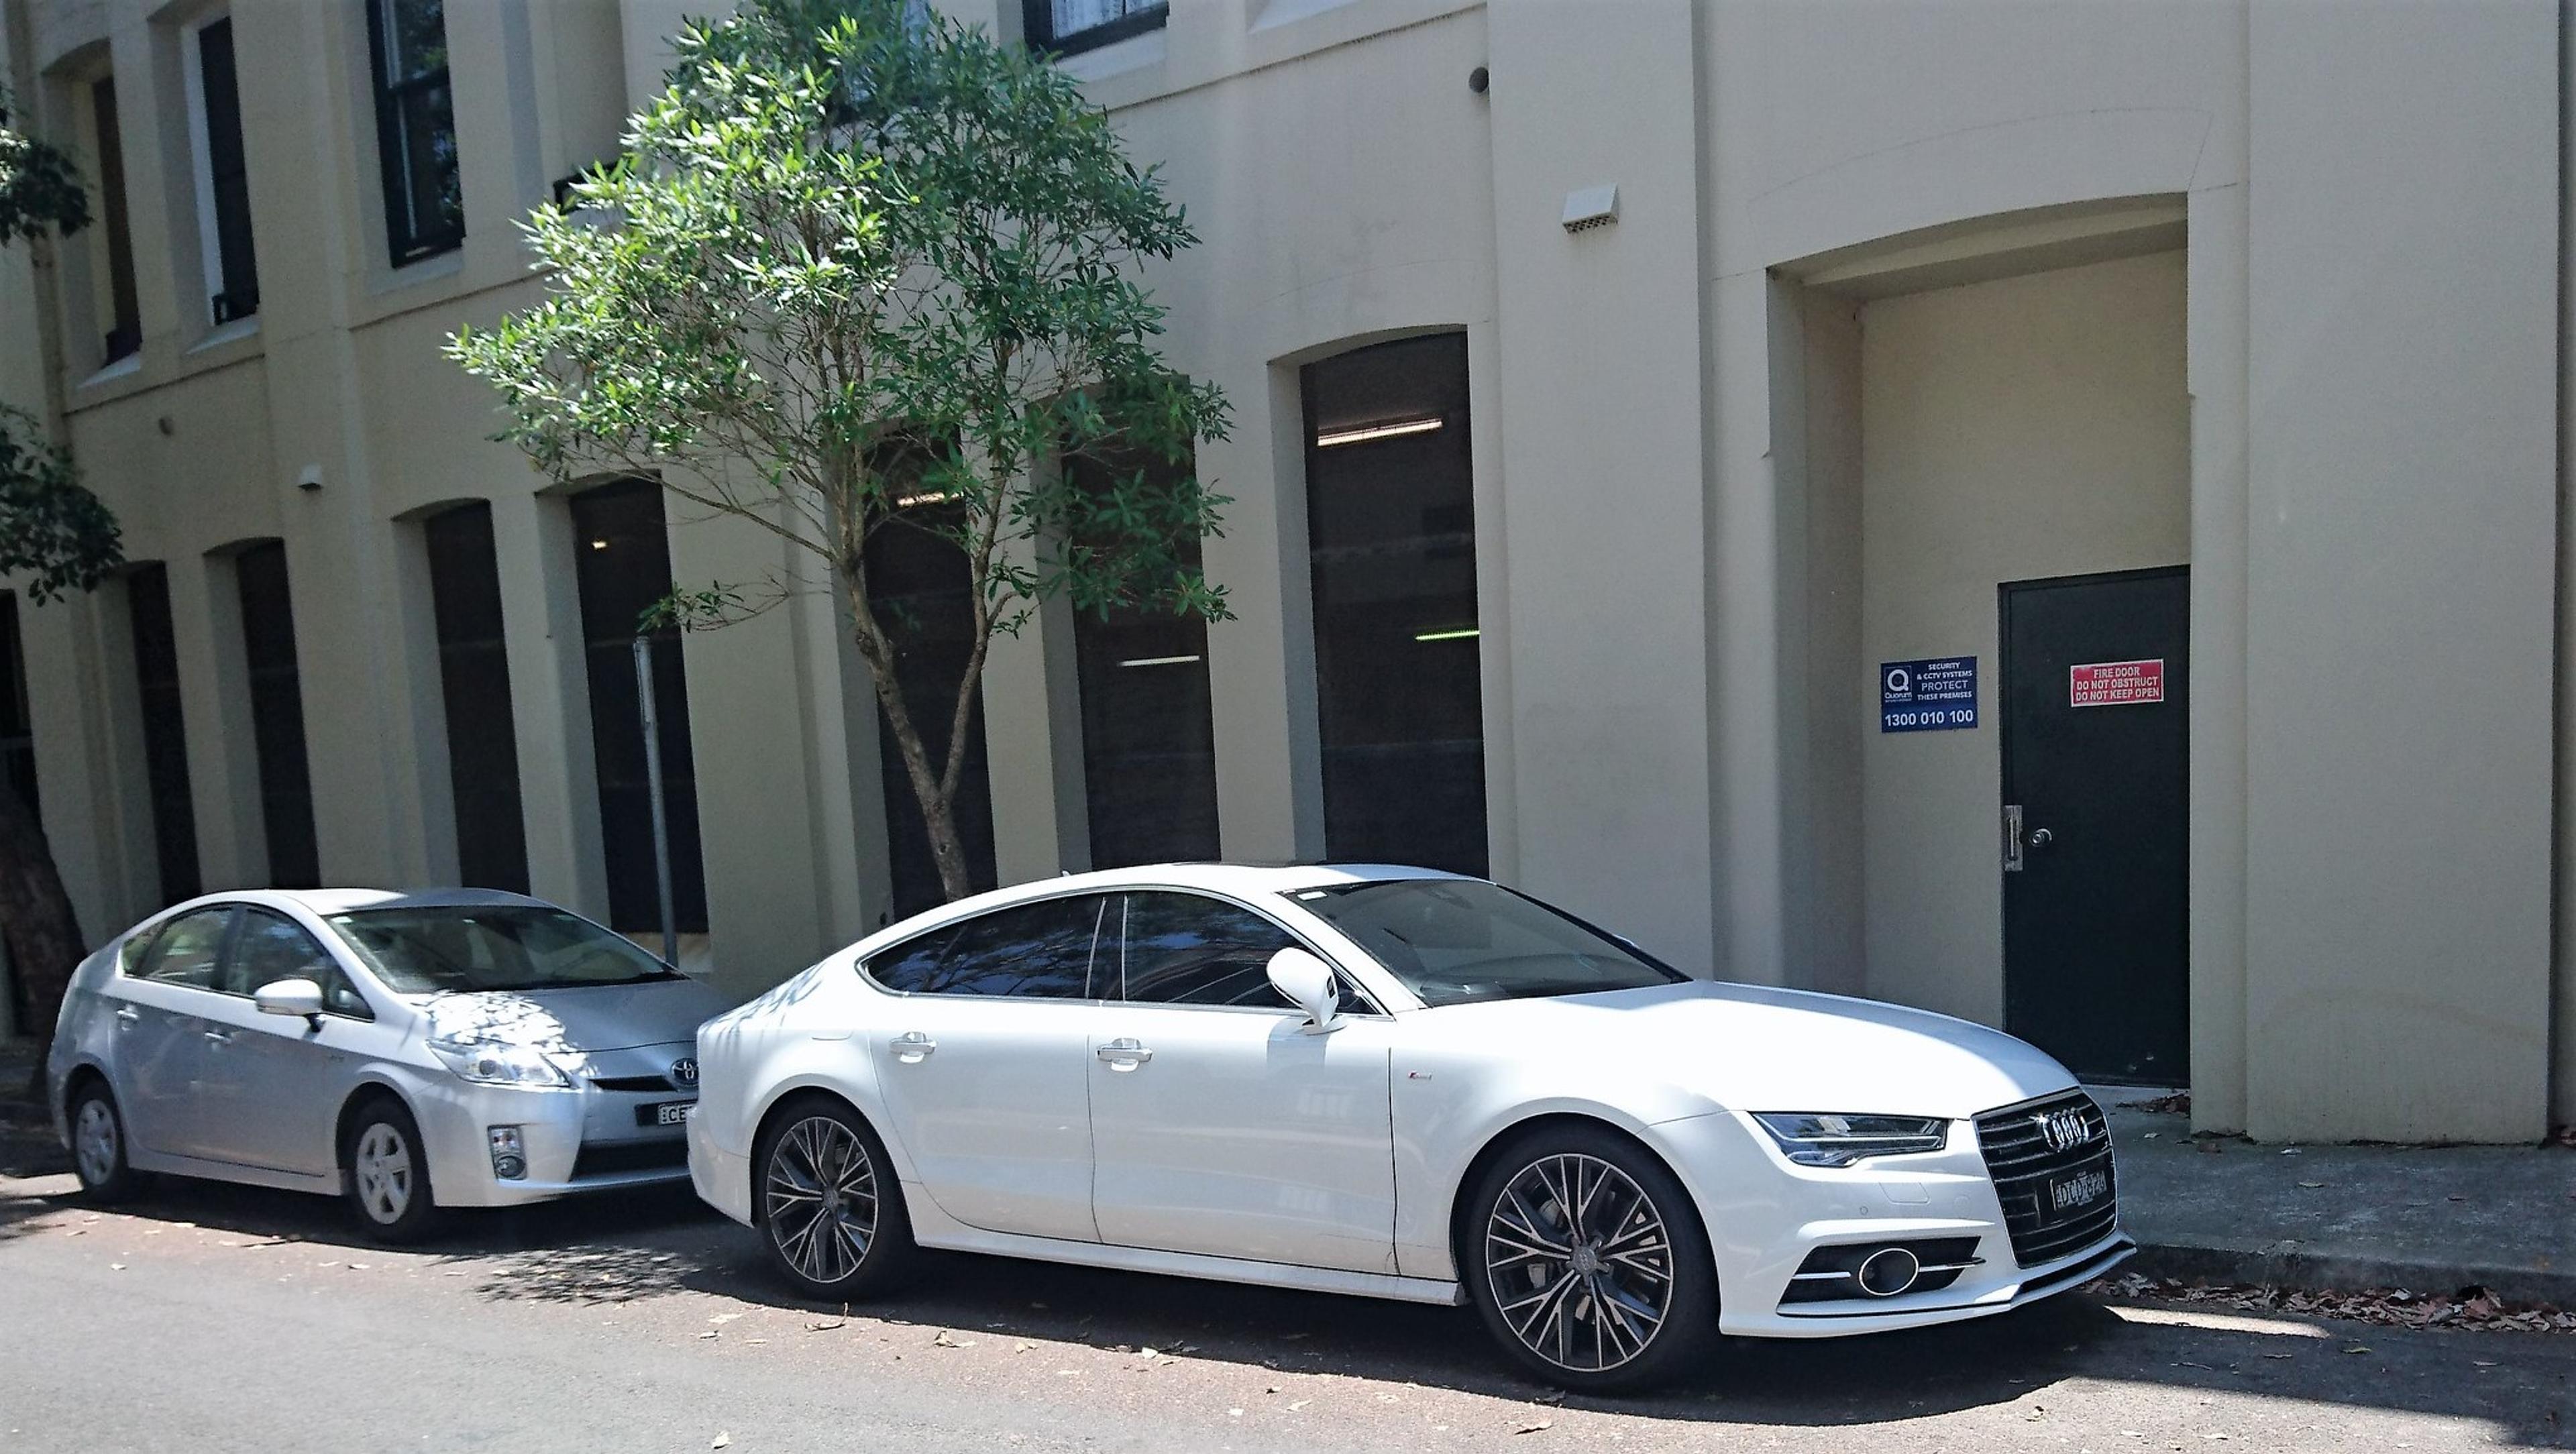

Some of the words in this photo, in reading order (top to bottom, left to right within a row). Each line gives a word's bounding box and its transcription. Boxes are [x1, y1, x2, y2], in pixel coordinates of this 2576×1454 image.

[1929, 662, 1960, 670] SECURITY
[1943, 670, 1972, 679] SYSTEMS
[2094, 669, 2114, 678] FIRE
[2115, 667, 2140, 677] DOOR
[1888, 669, 1909, 691] Q
[1921, 680, 1968, 691] PROTECT
[2077, 681, 2088, 690] DO
[2091, 679, 2109, 689] NOT
[2111, 677, 2157, 688] OBSTRUCT
[1939, 691, 1972, 700] PREMISES
[2076, 692, 2088, 702] DO
[2090, 691, 2108, 700] NOT
[2110, 689, 2133, 699] KEEP
[2135, 687, 2159, 697] OPEN
[1885, 713, 1917, 726] 1300
[1921, 712, 1945, 724] 010
[1949, 710, 1974, 723] 100
[669, 1107, 692, 1121] CE
